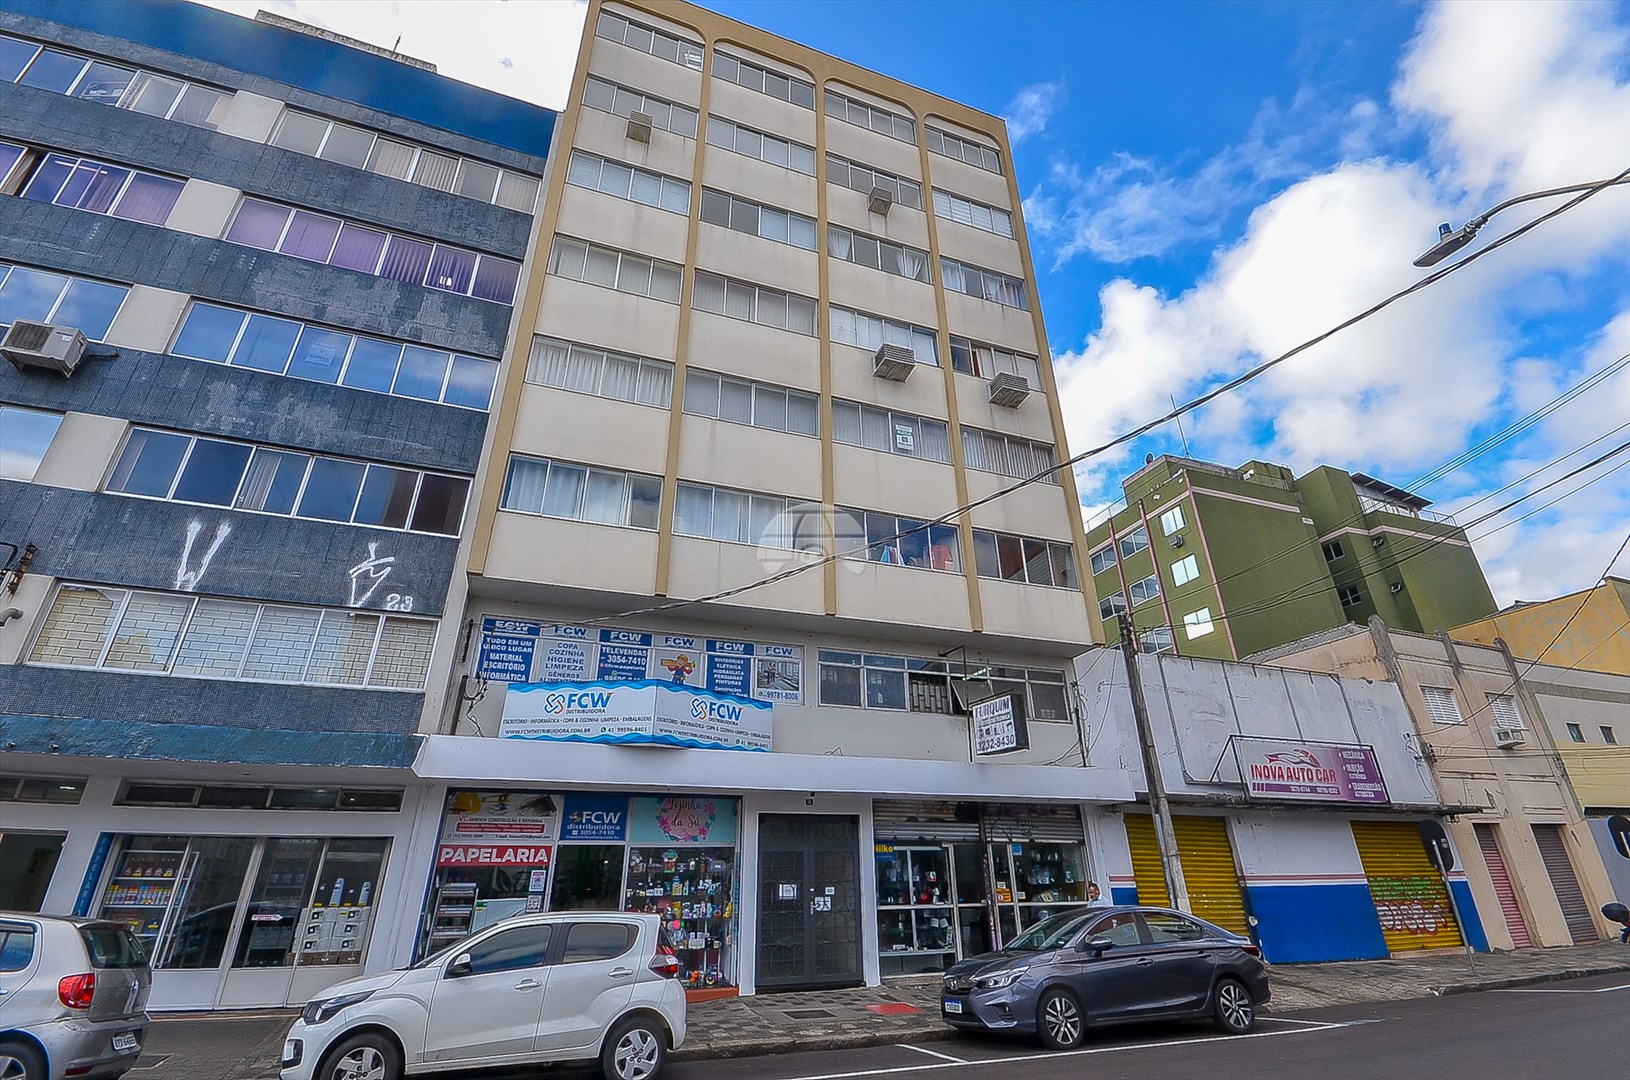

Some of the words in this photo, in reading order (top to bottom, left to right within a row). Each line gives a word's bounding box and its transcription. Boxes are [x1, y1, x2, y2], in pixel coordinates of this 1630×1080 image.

[554, 626, 587, 636] FCW
[610, 631, 642, 641] FCW
[557, 642, 579, 650] COPA
[664, 636, 695, 646] FCW
[602, 646, 647, 657] TELEVENDAS
[716, 642, 745, 651] FCW
[765, 646, 793, 656] FCW
[490, 653, 524, 662] MATERIAL
[548, 649, 585, 657] COZINHA
[484, 660, 526, 671] ESCRITÓRIO
[547, 656, 584, 665] HIGIENE
[607, 655, 646, 666] 3054-7410
[545, 663, 584, 672] LIMPEZA
[479, 671, 526, 682] INFORMÁTICA
[548, 670, 580, 679] GÊNEROS
[766, 690, 799, 700] 99781-8006
[566, 692, 614, 709] FCW
[708, 701, 744, 721] FCW
[708, 717, 739, 726] DISTRIBUIDORA
[978, 734, 1014, 752] 3232-8430
[1250, 764, 1285, 781] INOVA
[1286, 766, 1314, 783] AUTO
[1316, 768, 1337, 784] CAR
[582, 812, 622, 824] FCW
[671, 815, 684, 827] da
[440, 848, 548, 863] PAPELARIA
